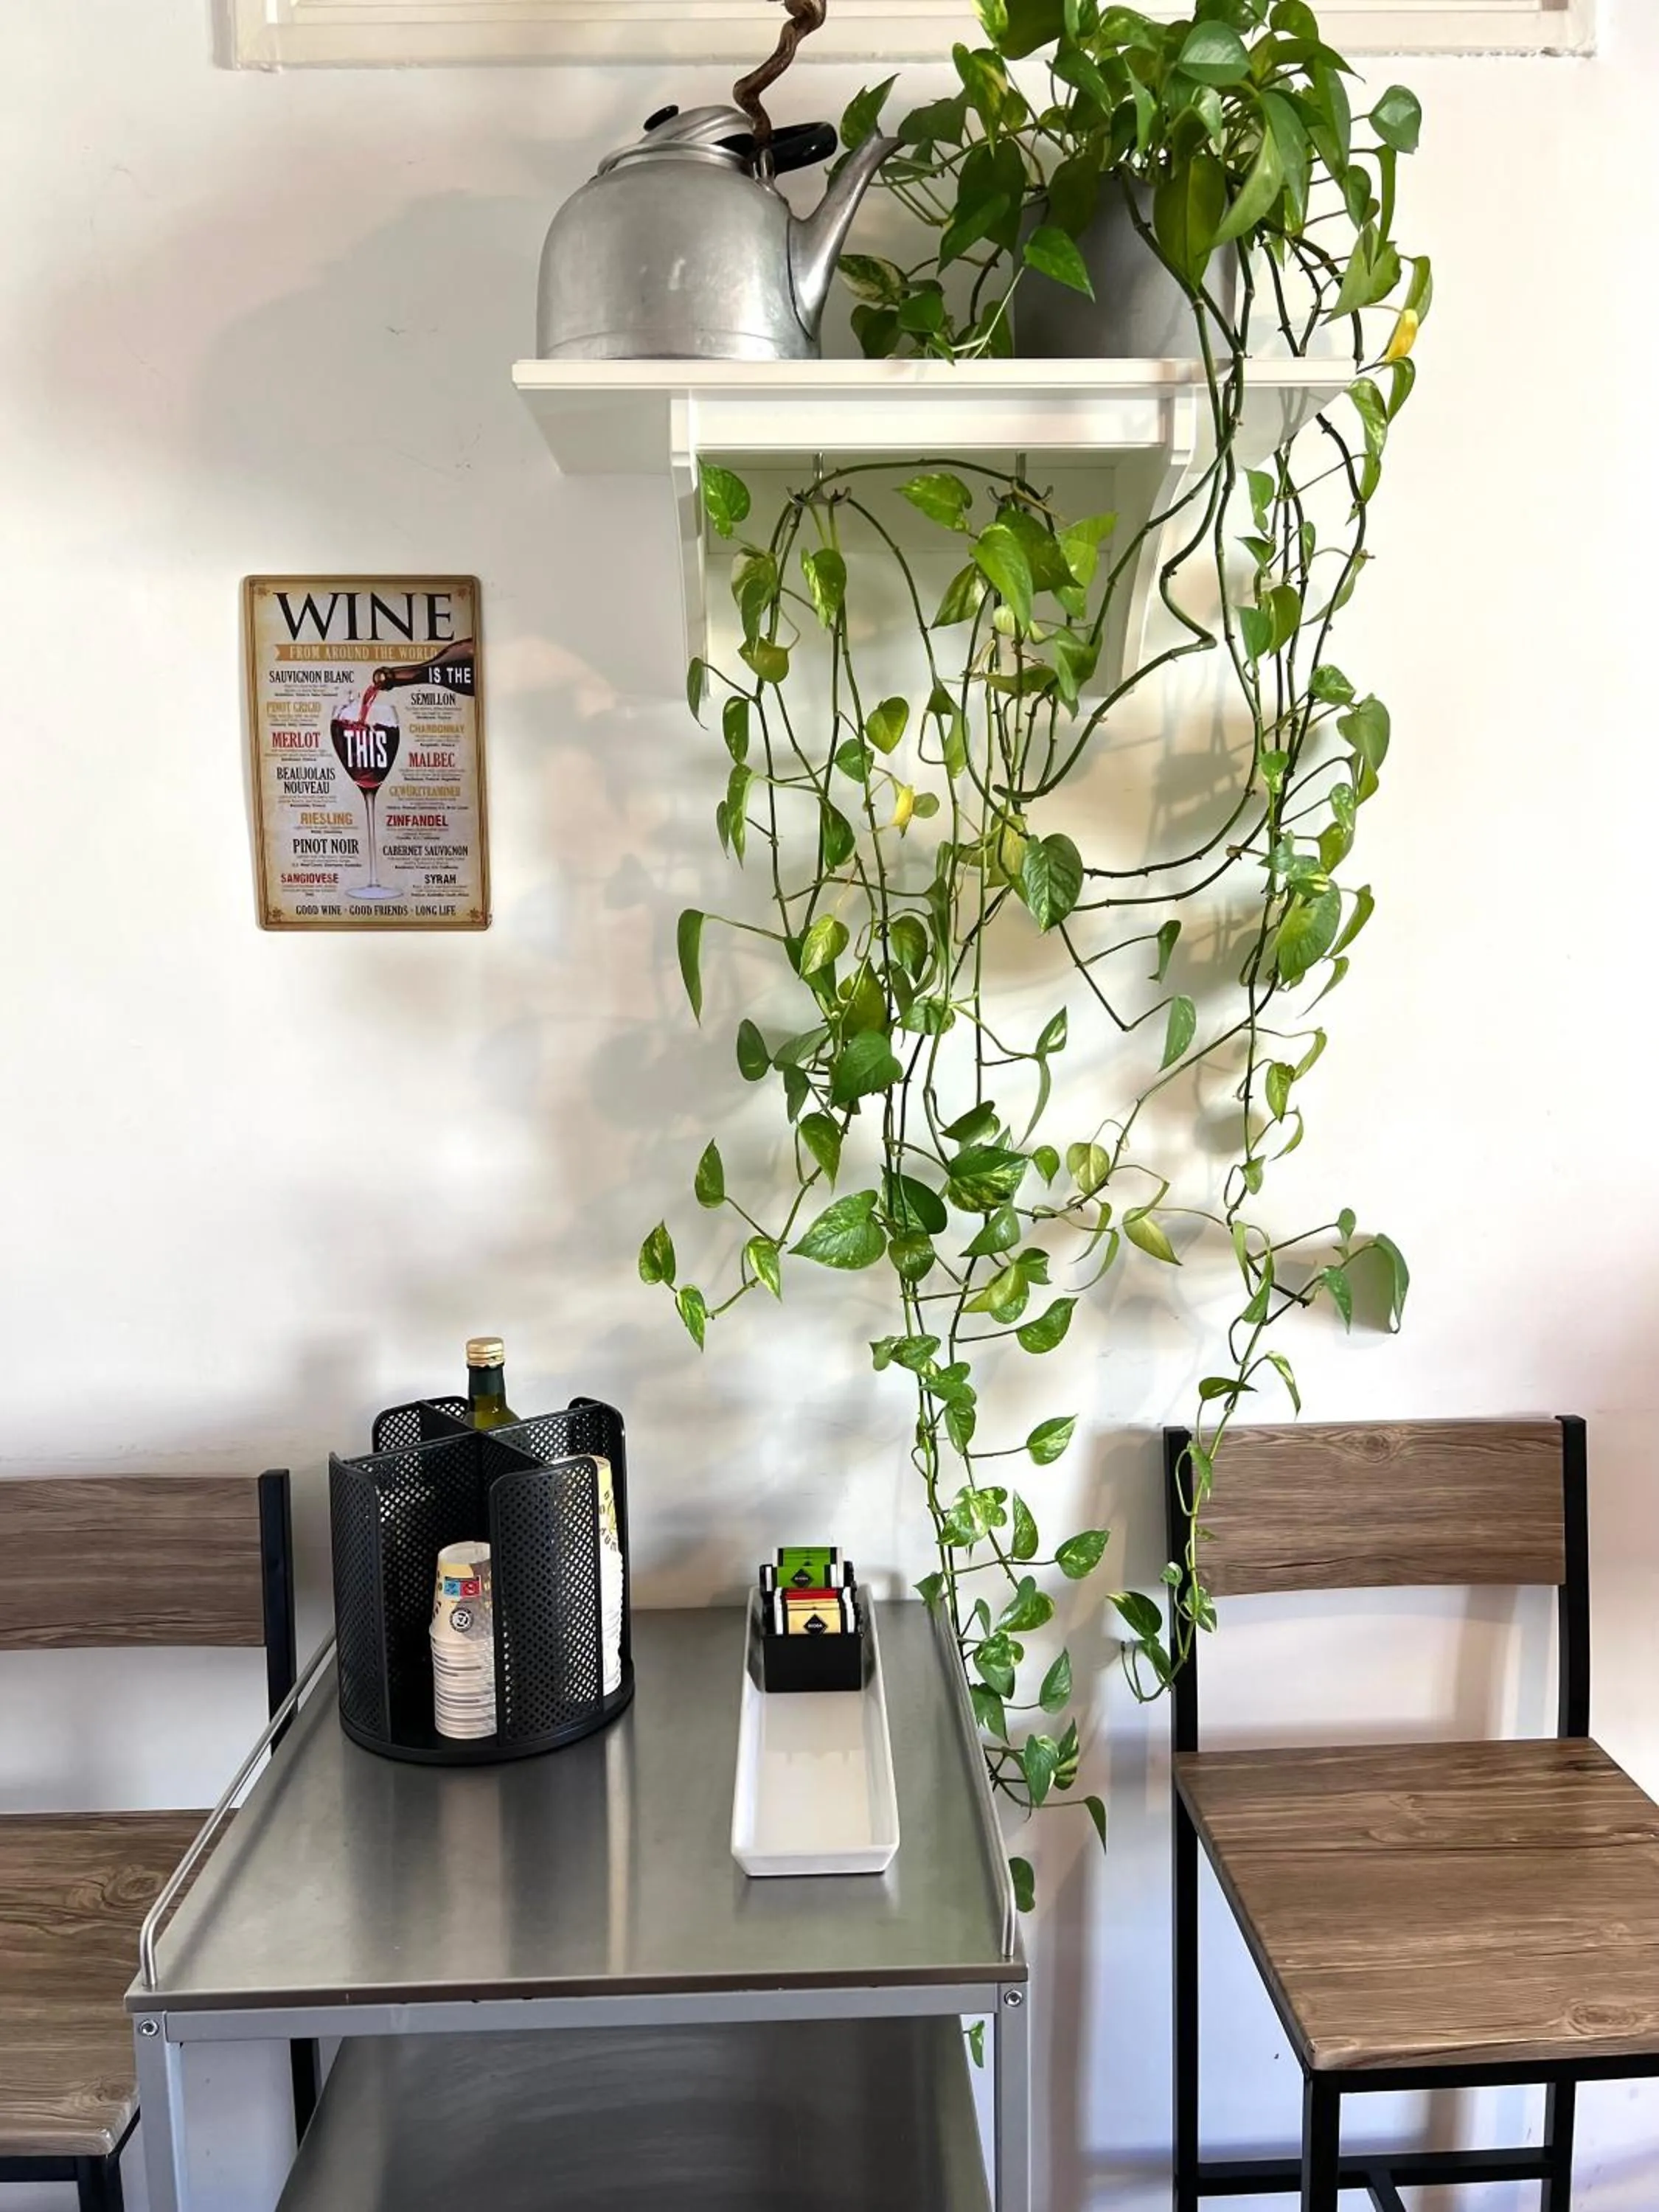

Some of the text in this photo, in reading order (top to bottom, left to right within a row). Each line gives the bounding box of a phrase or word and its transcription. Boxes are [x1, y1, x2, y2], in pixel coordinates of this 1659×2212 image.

[273, 592, 454, 641] WINE
[290, 645, 438, 661] FROM AROUND THE WORLD
[269, 670, 355, 684] SAUVIGNON BLANC
[428, 667, 472, 684] IS THE
[411, 689, 456, 706] SÉMILLON
[409, 723, 465, 734] CHARDONNAY
[272, 731, 321, 748] MERLOT
[344, 730, 387, 768] THIS
[408, 753, 456, 768] MALBEC
[276, 767, 335, 780] BEAUJOLAIS
[284, 782, 330, 794] NOUVEAU
[300, 813, 353, 825] RIESLING
[386, 815, 449, 827] ZINFANDEL
[293, 838, 360, 855] PINOT NOIR
[383, 845, 469, 856] CABERNET SAUVIGNON
[281, 873, 339, 884] SANGIOVESE
[424, 874, 456, 884] SYRAH
[296, 905, 457, 916] GOOD WINE GOOD FRIENDS LONG LIFE
